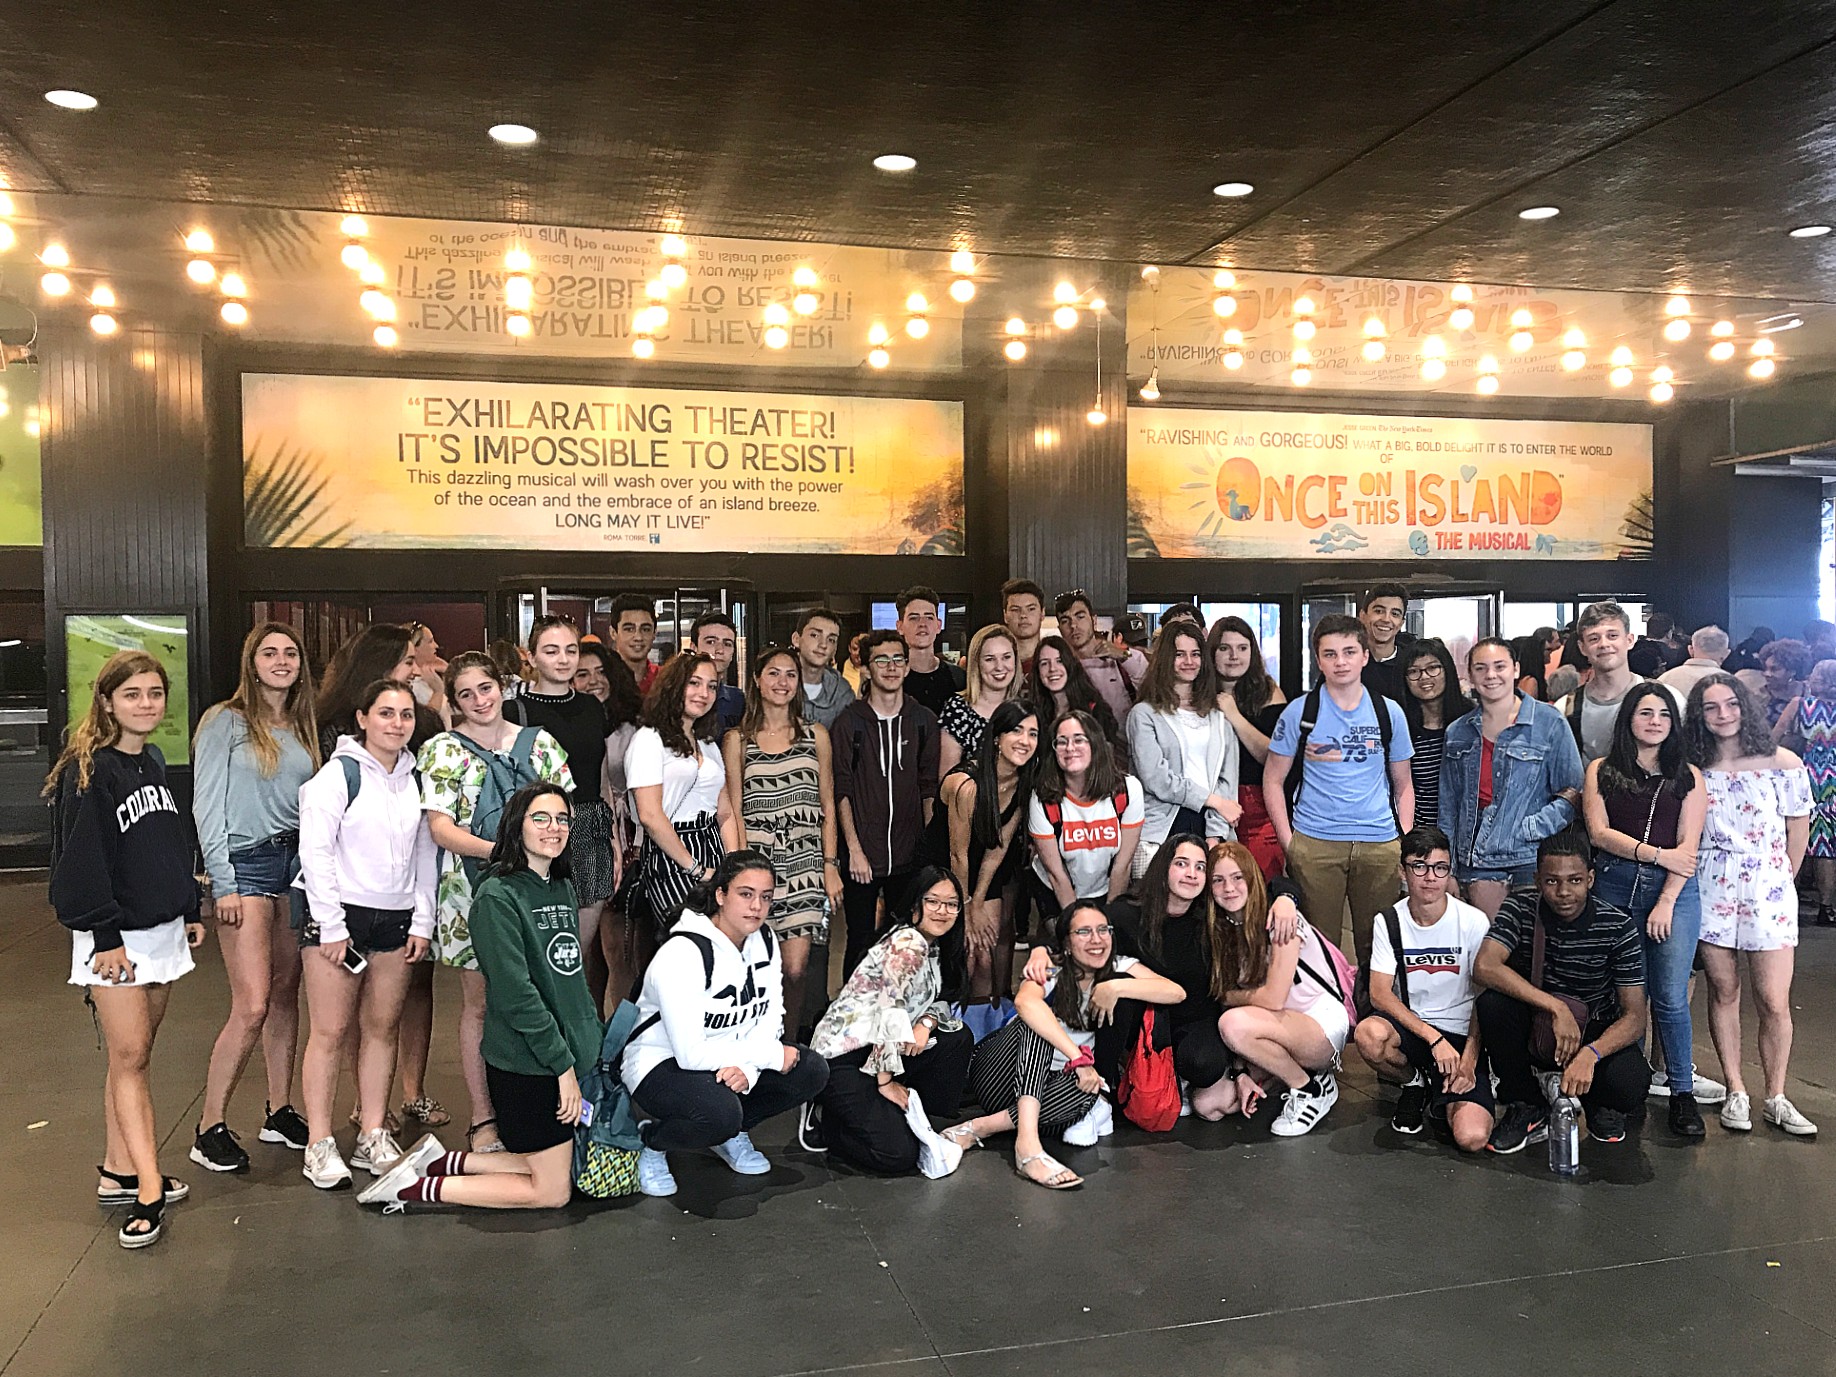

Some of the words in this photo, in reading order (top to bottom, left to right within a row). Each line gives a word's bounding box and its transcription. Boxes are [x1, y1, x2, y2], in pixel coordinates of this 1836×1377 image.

[408, 397, 672, 433] "EXHILARATING
[684, 405, 835, 439] THEATER!
[398, 432, 461, 464] IT'S
[474, 434, 669, 467] IMPOSSIBLE
[682, 440, 729, 470] TO
[742, 442, 855, 474] RESIST!
[1140, 428, 1228, 446] "RAVISHING
[1233, 436, 1255, 447] AND
[1259, 431, 1348, 450] GORGEOUS!
[1352, 439, 1382, 451] WHAT
[1385, 440, 1393, 451] A
[1416, 441, 1441, 452] BOLD
[1444, 442, 1484, 453] DELIGHT
[1486, 443, 1496, 454] IT
[1499, 443, 1508, 454] IS
[1511, 443, 1523, 454] TO
[1526, 444, 1556, 455] ENTER
[1559, 445, 1577, 456] THE
[1580, 446, 1613, 457] WORLD
[1380, 453, 1394, 464] OF
[406, 469, 441, 484] This
[446, 470, 511, 489] dazzling
[517, 472, 576, 487] musical
[581, 472, 608, 487] will
[614, 474, 655, 488] wash
[660, 477, 694, 489] over
[699, 478, 727, 493] you
[732, 477, 765, 491] with
[770, 478, 793, 492] the
[798, 481, 843, 496] power
[1216, 457, 1348, 529] ONCE
[1359, 471, 1392, 497] ON
[434, 490, 452, 505] of
[457, 491, 483, 506] the
[488, 494, 537, 507] ocean
[542, 493, 571, 507] and
[577, 493, 601, 508] the
[606, 494, 672, 509] embrace
[678, 495, 694, 509] of
[699, 498, 717, 510] an
[722, 496, 763, 511] island
[768, 497, 820, 512] breeze.
[1352, 499, 1400, 525] THIS
[555, 513, 602, 528] LONG
[607, 514, 641, 528] MAY
[646, 515, 661, 529] IT
[666, 514, 711, 530] LIVE!"
[1435, 531, 1463, 550] THE
[1468, 531, 1531, 550] MUSICAL
[1342, 743, 1367, 763] 73
